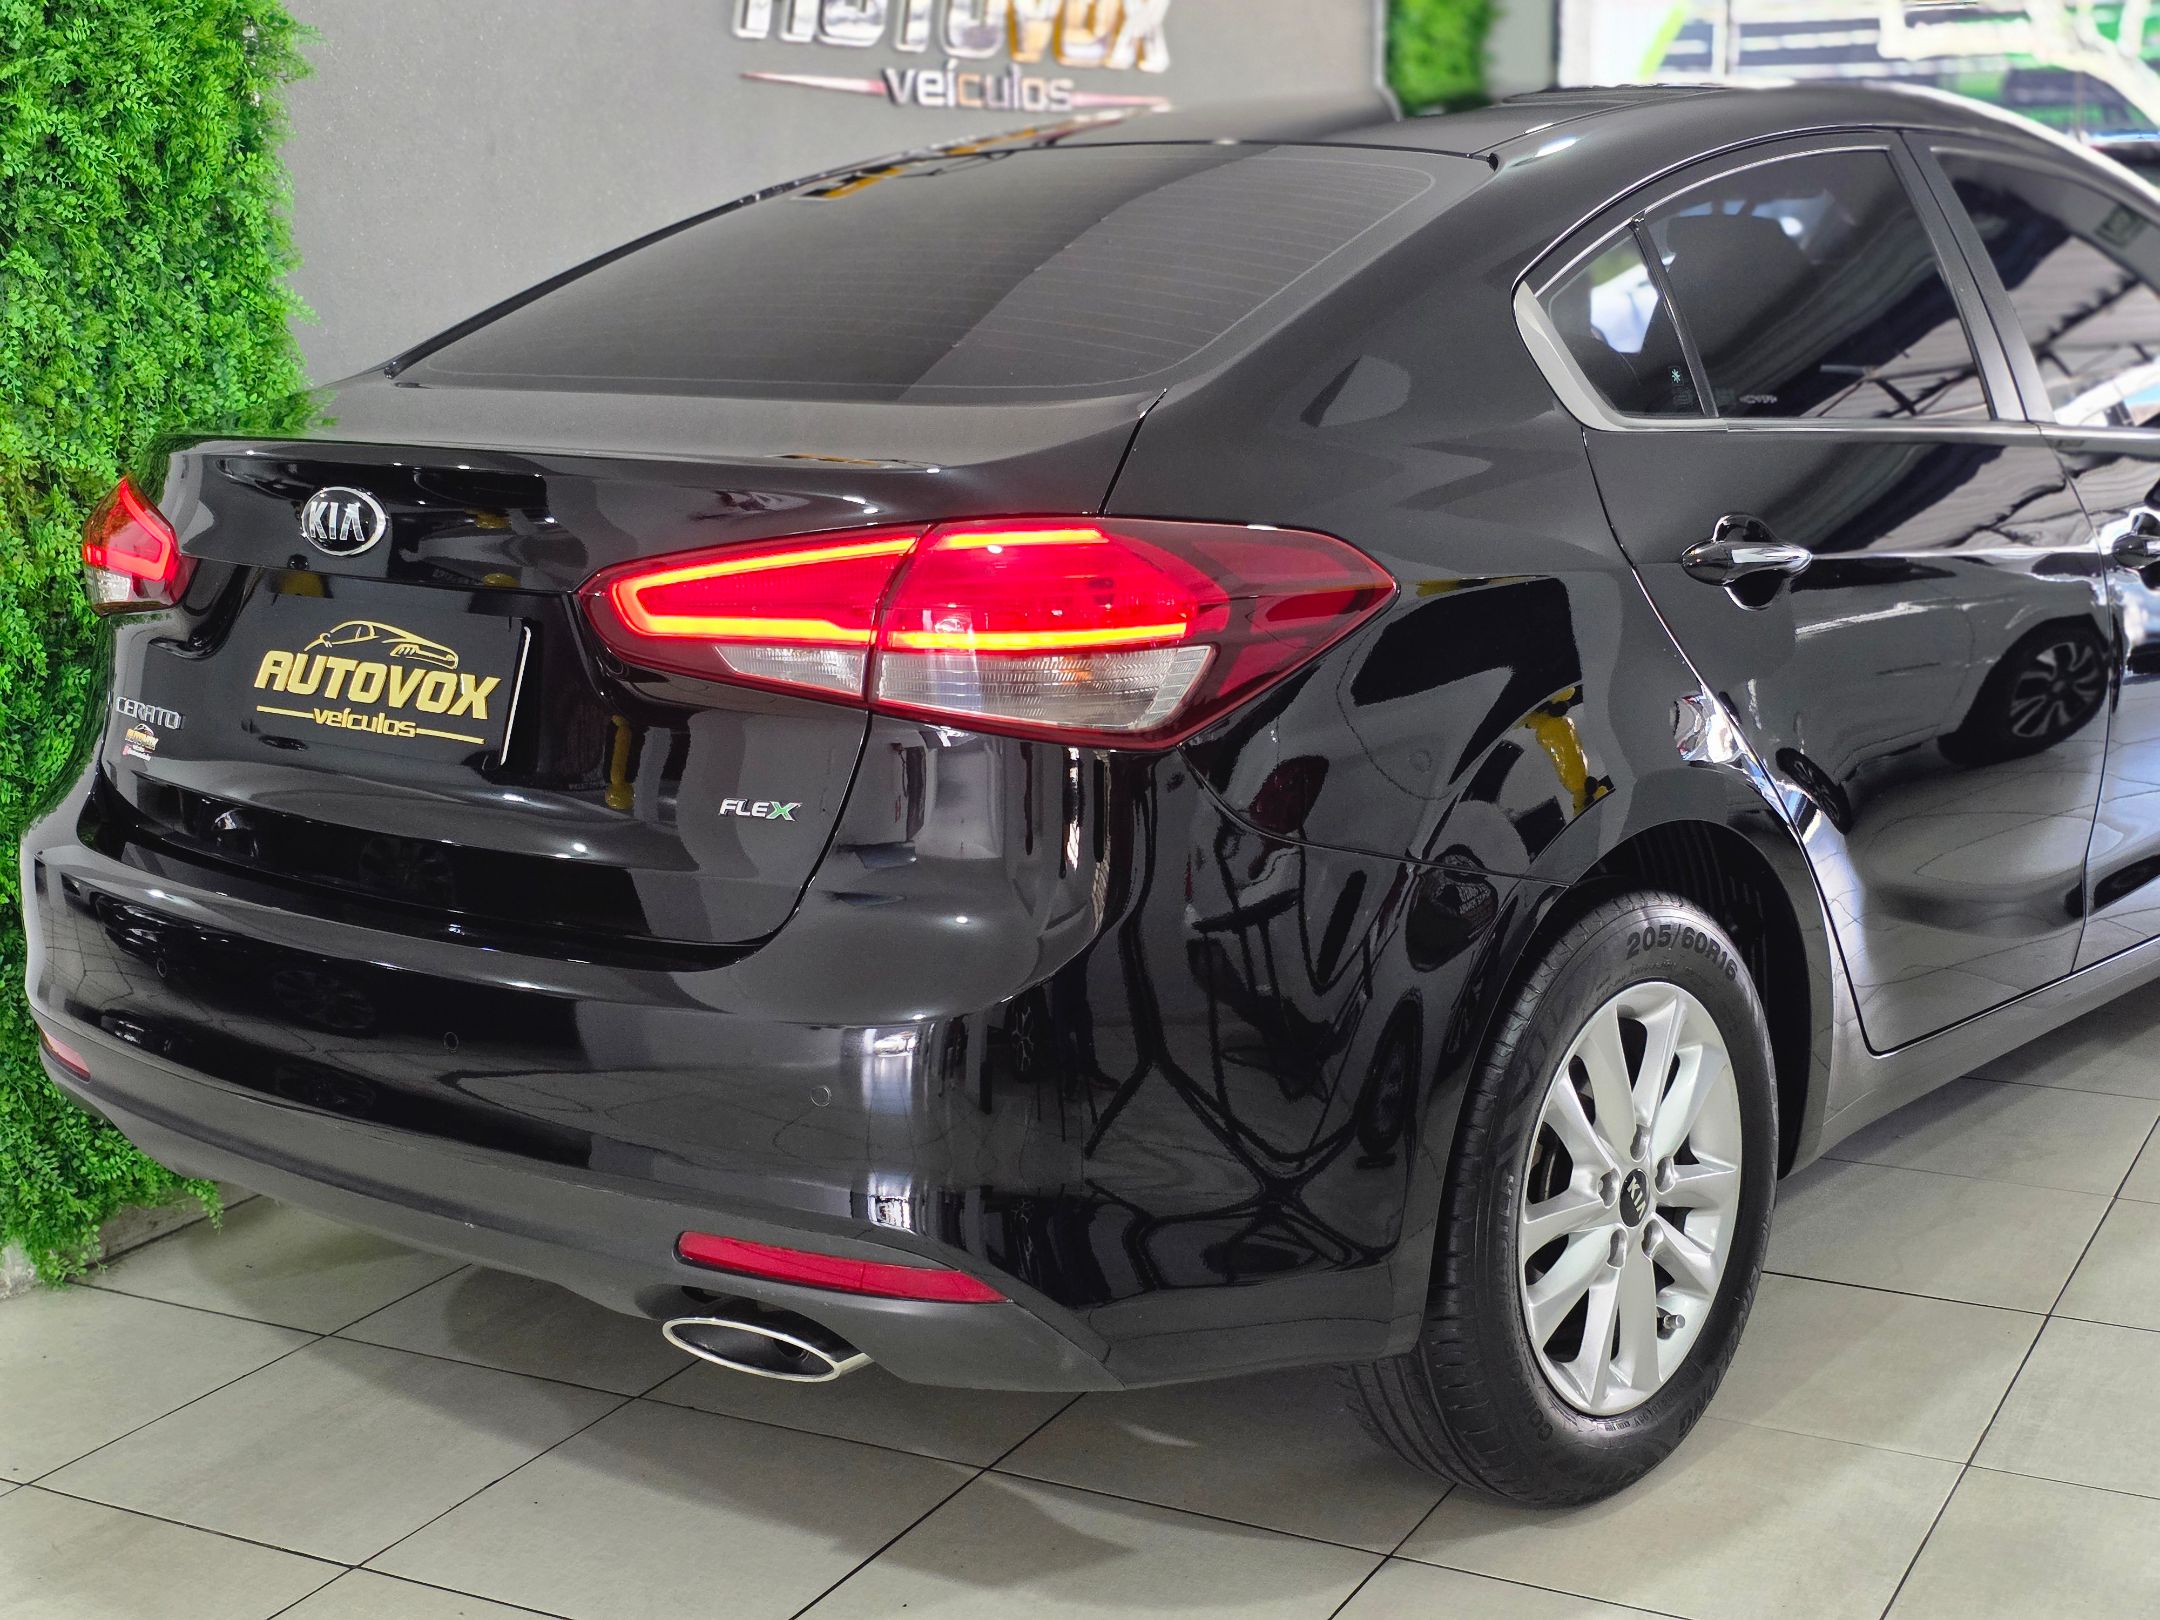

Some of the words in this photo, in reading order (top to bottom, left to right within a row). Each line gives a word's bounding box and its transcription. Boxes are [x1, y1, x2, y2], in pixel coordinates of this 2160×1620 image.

[884, 60, 1074, 112] veículos
[309, 501, 365, 541] KIA
[254, 650, 501, 720] AUTOVOX
[116, 696, 181, 730] CERATO
[313, 707, 417, 738] veículos
[719, 798, 803, 821] FLEX
[1626, 923, 1738, 981] 205/60R16
[1627, 1176, 1646, 1220] KIA
